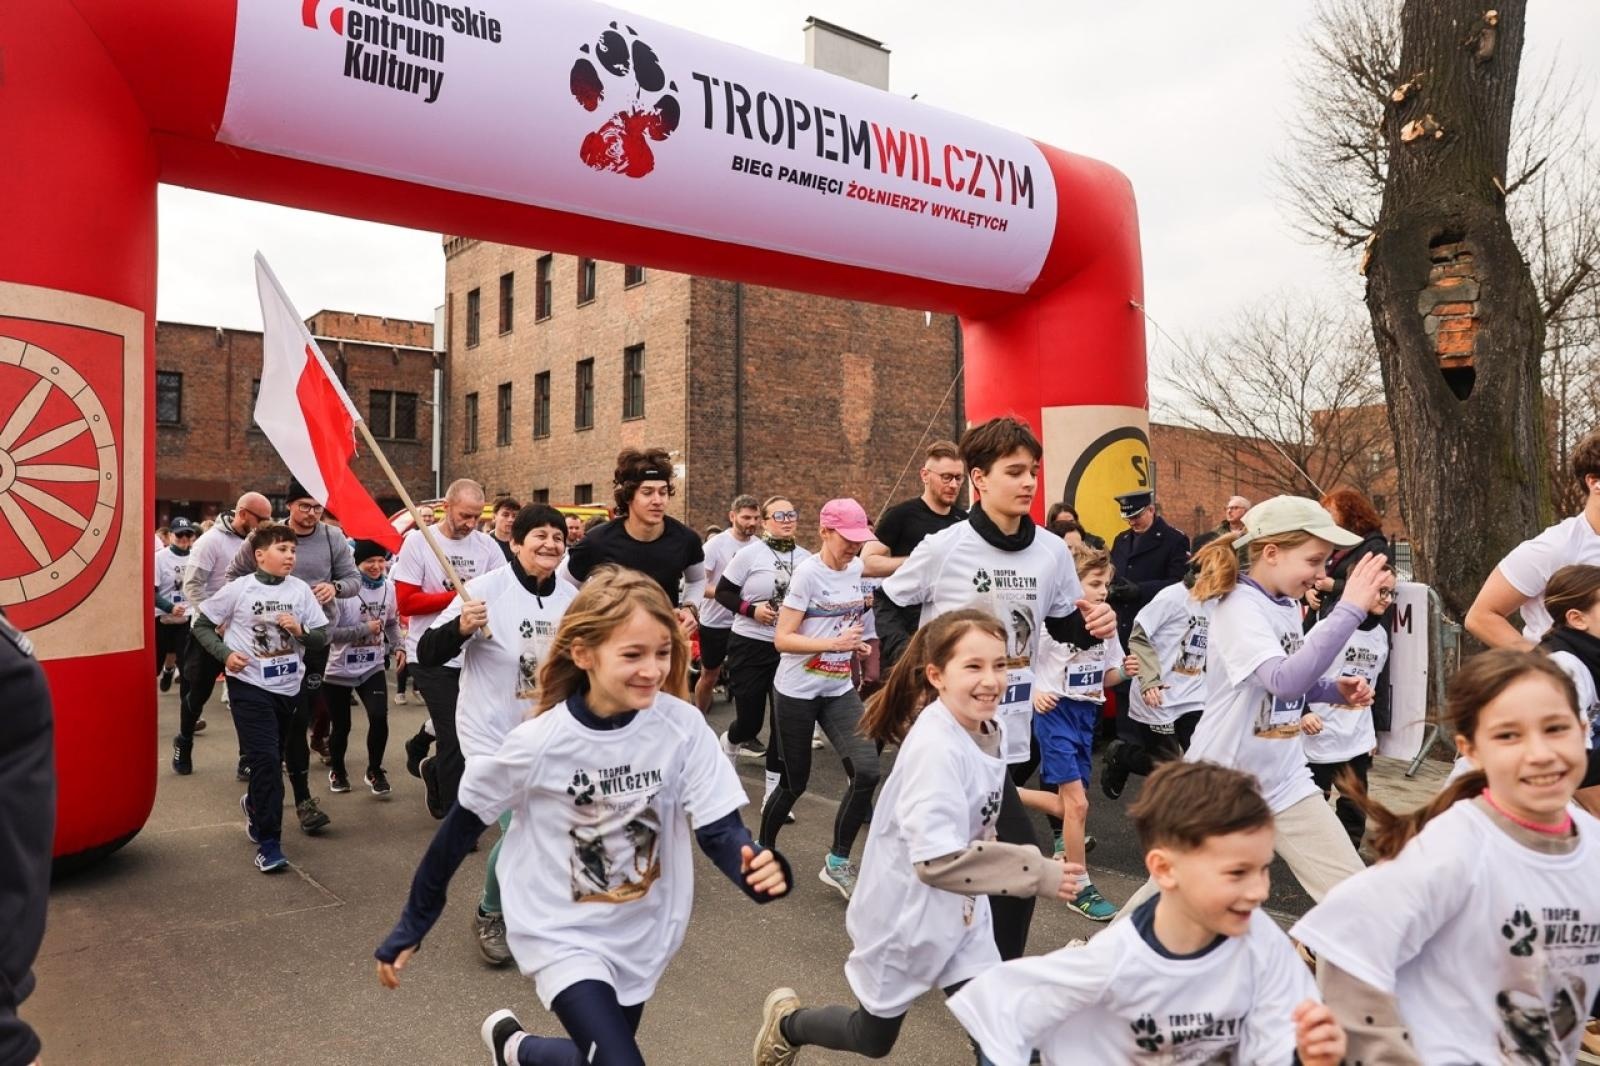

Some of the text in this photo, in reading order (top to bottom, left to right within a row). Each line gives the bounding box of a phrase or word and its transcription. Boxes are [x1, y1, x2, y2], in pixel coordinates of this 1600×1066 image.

[347, 10, 445, 63] entrum
[344, 40, 444, 104] Kultury
[731, 155, 1009, 232] BIEG PAMIĘCI ŻOŁNIERZY WYKLĘTYCH
[994, 576, 1037, 588] WILCZYM
[275, 664, 290, 676] 12
[1080, 673, 1096, 685] 41
[598, 764, 631, 778] TROPEM
[600, 769, 663, 796] WILCZYM
[1542, 907, 1581, 921] TROPEM
[1544, 923, 1600, 945] WILCZY
[1168, 1012, 1214, 1027] TROPEM
